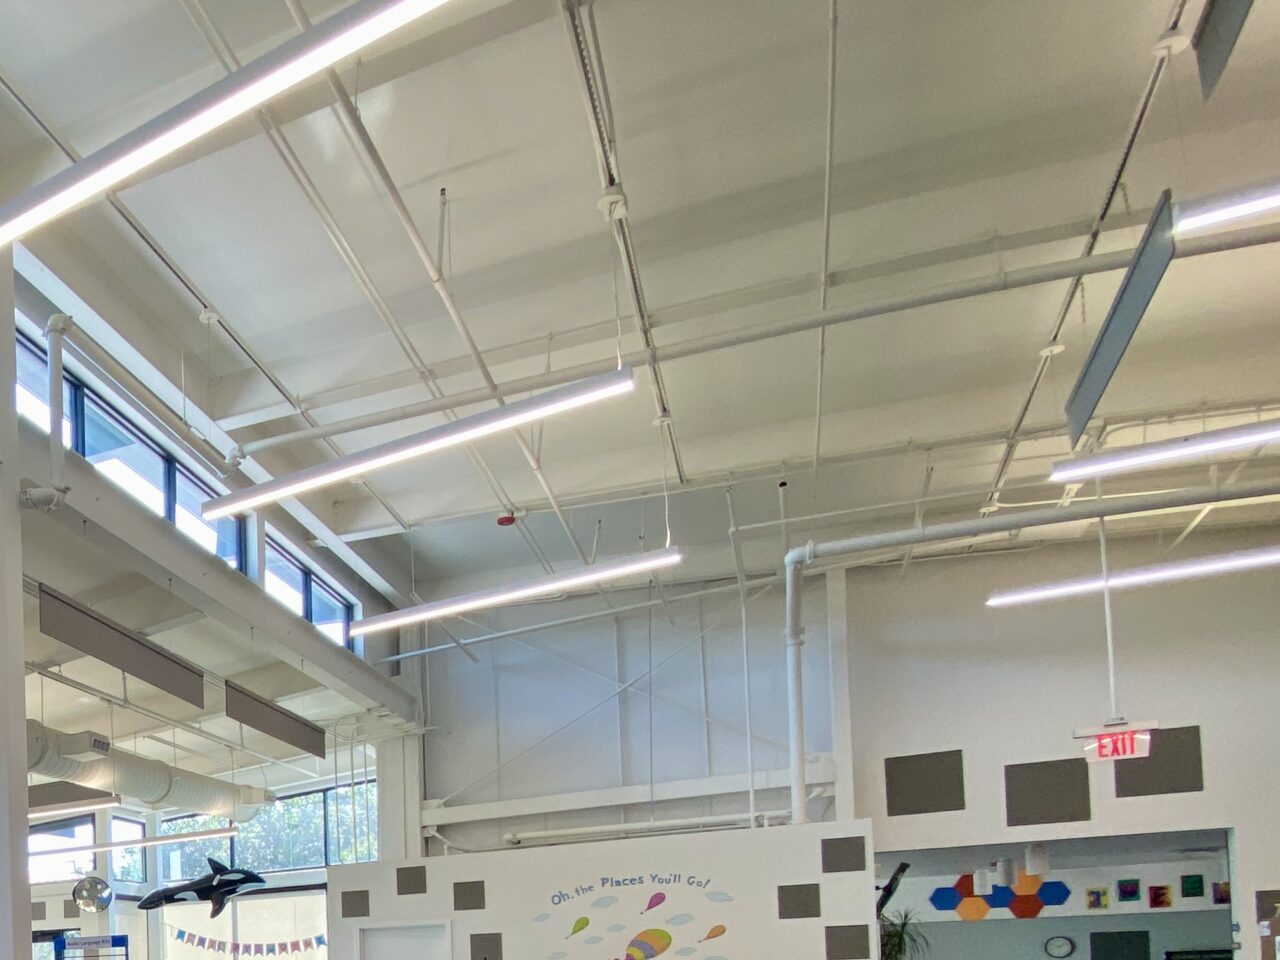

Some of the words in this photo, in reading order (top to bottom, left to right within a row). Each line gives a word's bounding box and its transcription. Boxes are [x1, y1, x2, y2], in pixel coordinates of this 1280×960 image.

[1098, 732, 1136, 758] EXIT
[574, 884, 595, 896] the
[600, 875, 644, 888] Places
[650, 874, 681, 885] You'll
[687, 876, 711, 889] Go!
